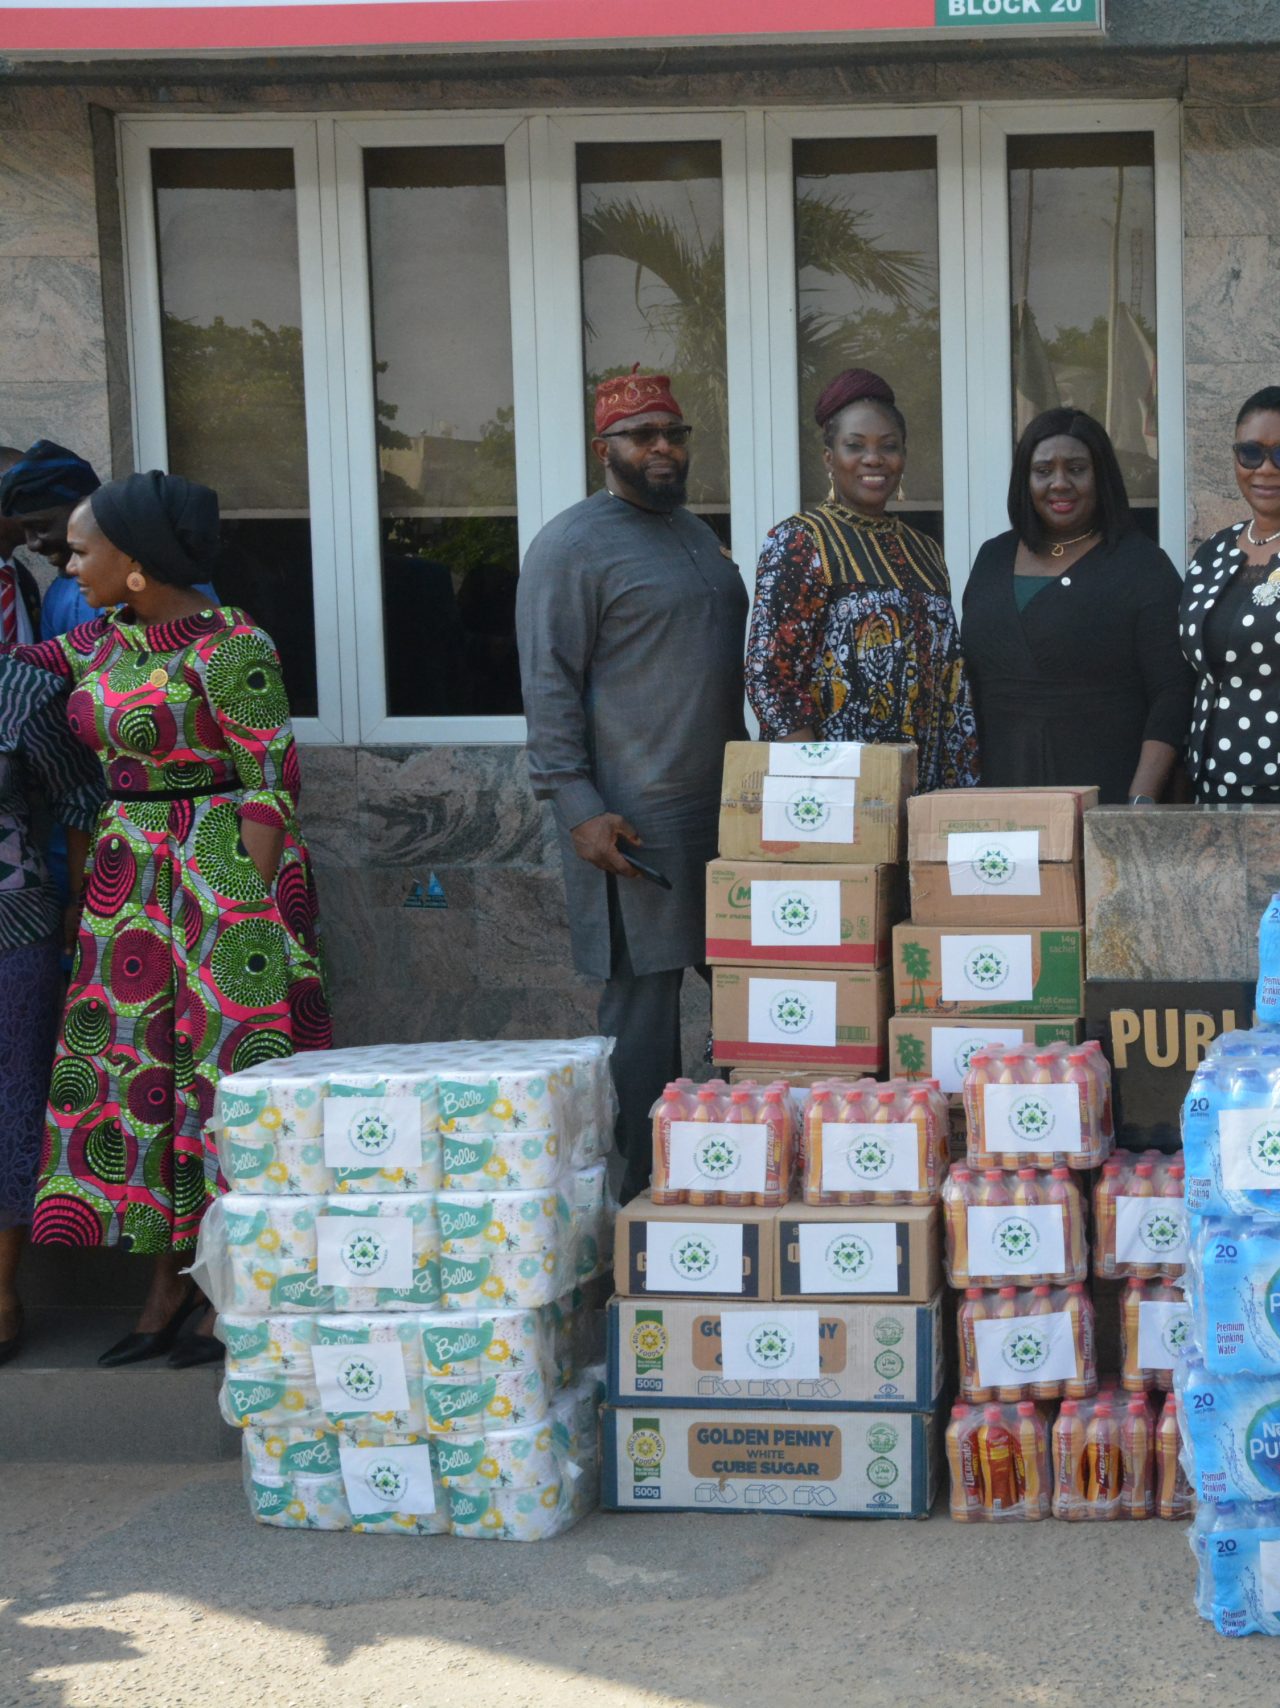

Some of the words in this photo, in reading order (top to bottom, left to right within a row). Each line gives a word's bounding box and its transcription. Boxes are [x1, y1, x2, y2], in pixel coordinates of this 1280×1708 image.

[948, 0, 1041, 16] BLOCK
[1050, 0, 1082, 12] 20
[1061, 936, 1076, 945] 14g
[444, 1090, 486, 1115] Belle
[1190, 1098, 1209, 1113] 20
[221, 1101, 254, 1123] Belle
[444, 1146, 480, 1170] Belle
[441, 1211, 480, 1237] Belle
[1215, 1244, 1237, 1258] 20
[441, 1264, 476, 1287] Belle
[633, 1324, 650, 1344] GOLDEN
[1216, 1322, 1245, 1332] Premium
[226, 1332, 260, 1355] Belle
[1217, 1334, 1244, 1343] Drinking
[437, 1336, 481, 1360] Belle
[1218, 1345, 1237, 1354] Water
[637, 1379, 662, 1390] 500g
[234, 1387, 275, 1412] Belle
[439, 1391, 481, 1416] Belle
[1193, 1393, 1214, 1409] 20
[697, 1428, 770, 1446] GOLDEN
[774, 1430, 834, 1447] PENNY
[439, 1447, 473, 1471] Belle
[747, 1449, 785, 1460] WHITE
[712, 1461, 757, 1474] CUBE
[760, 1462, 820, 1476] SUGAR
[1201, 1472, 1226, 1482] Premium
[635, 1488, 660, 1497] 500g
[1202, 1483, 1226, 1493] Drinking
[1216, 1539, 1237, 1553] 20
[1222, 1608, 1246, 1618] Premium
